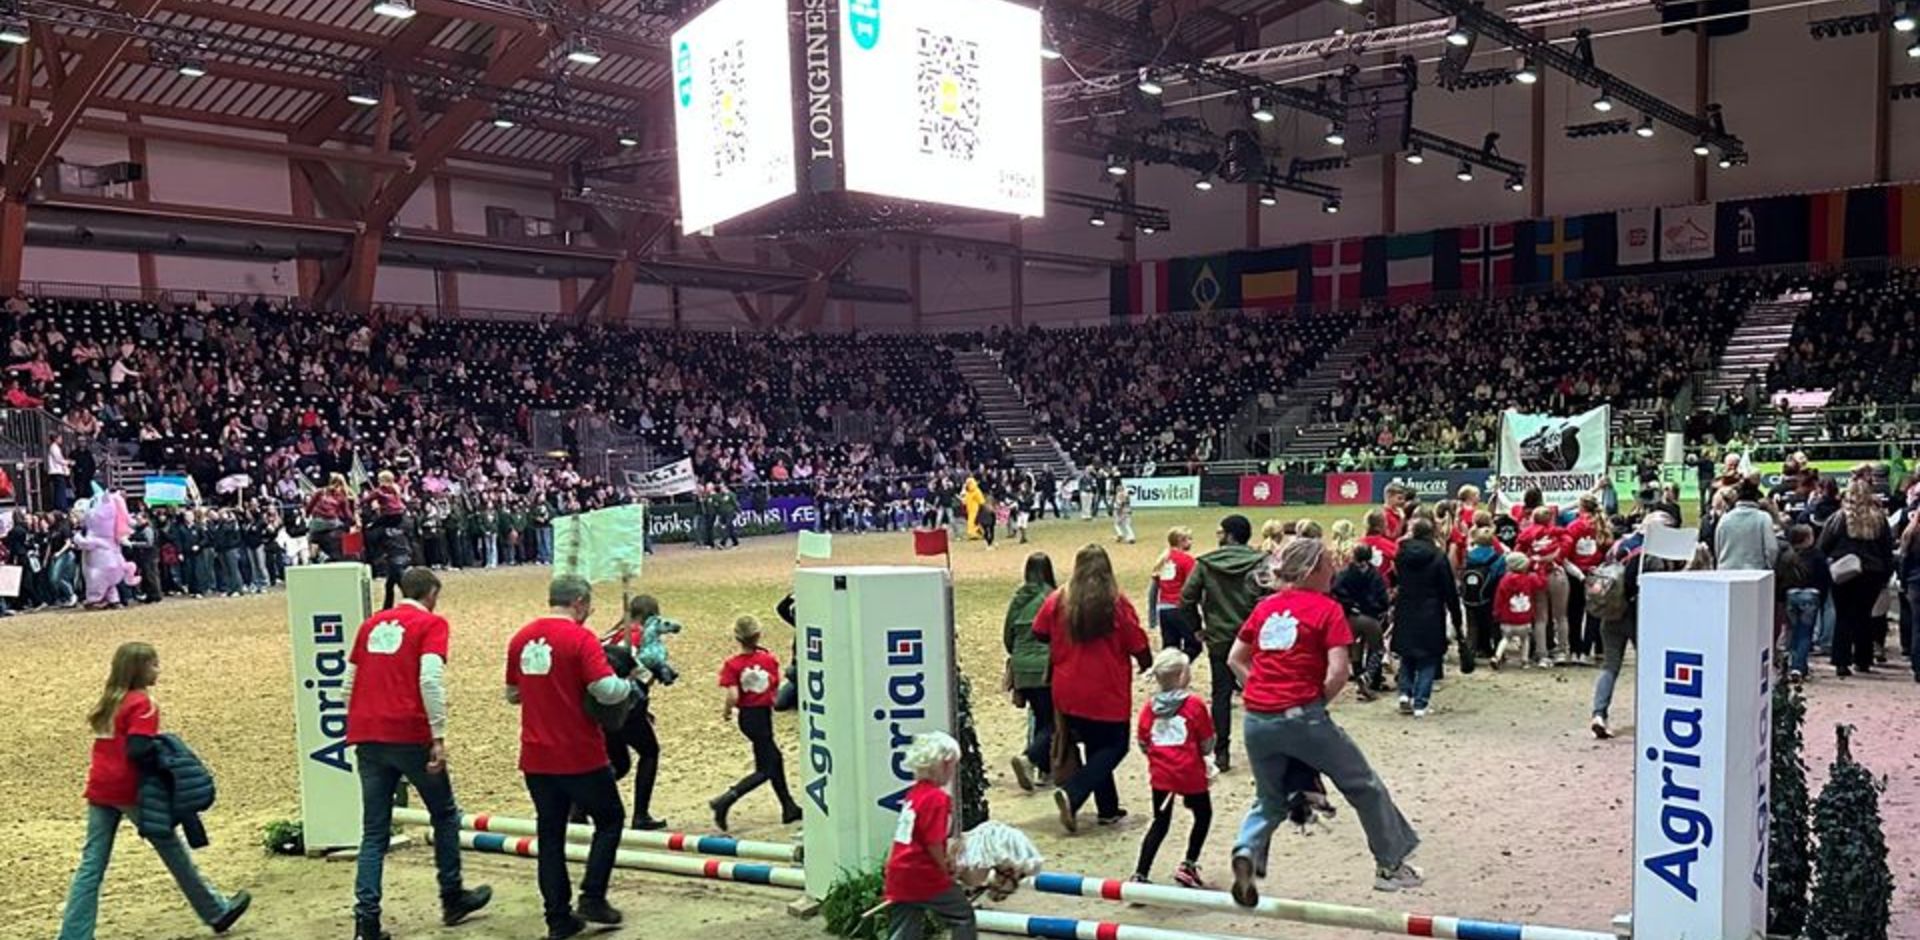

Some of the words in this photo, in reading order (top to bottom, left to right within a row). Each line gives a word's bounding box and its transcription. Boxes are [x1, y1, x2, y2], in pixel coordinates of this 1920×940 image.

[1127, 483, 1194, 500] Plusvital
[803, 670, 832, 816] Agria
[1644, 708, 1713, 902] Agria
